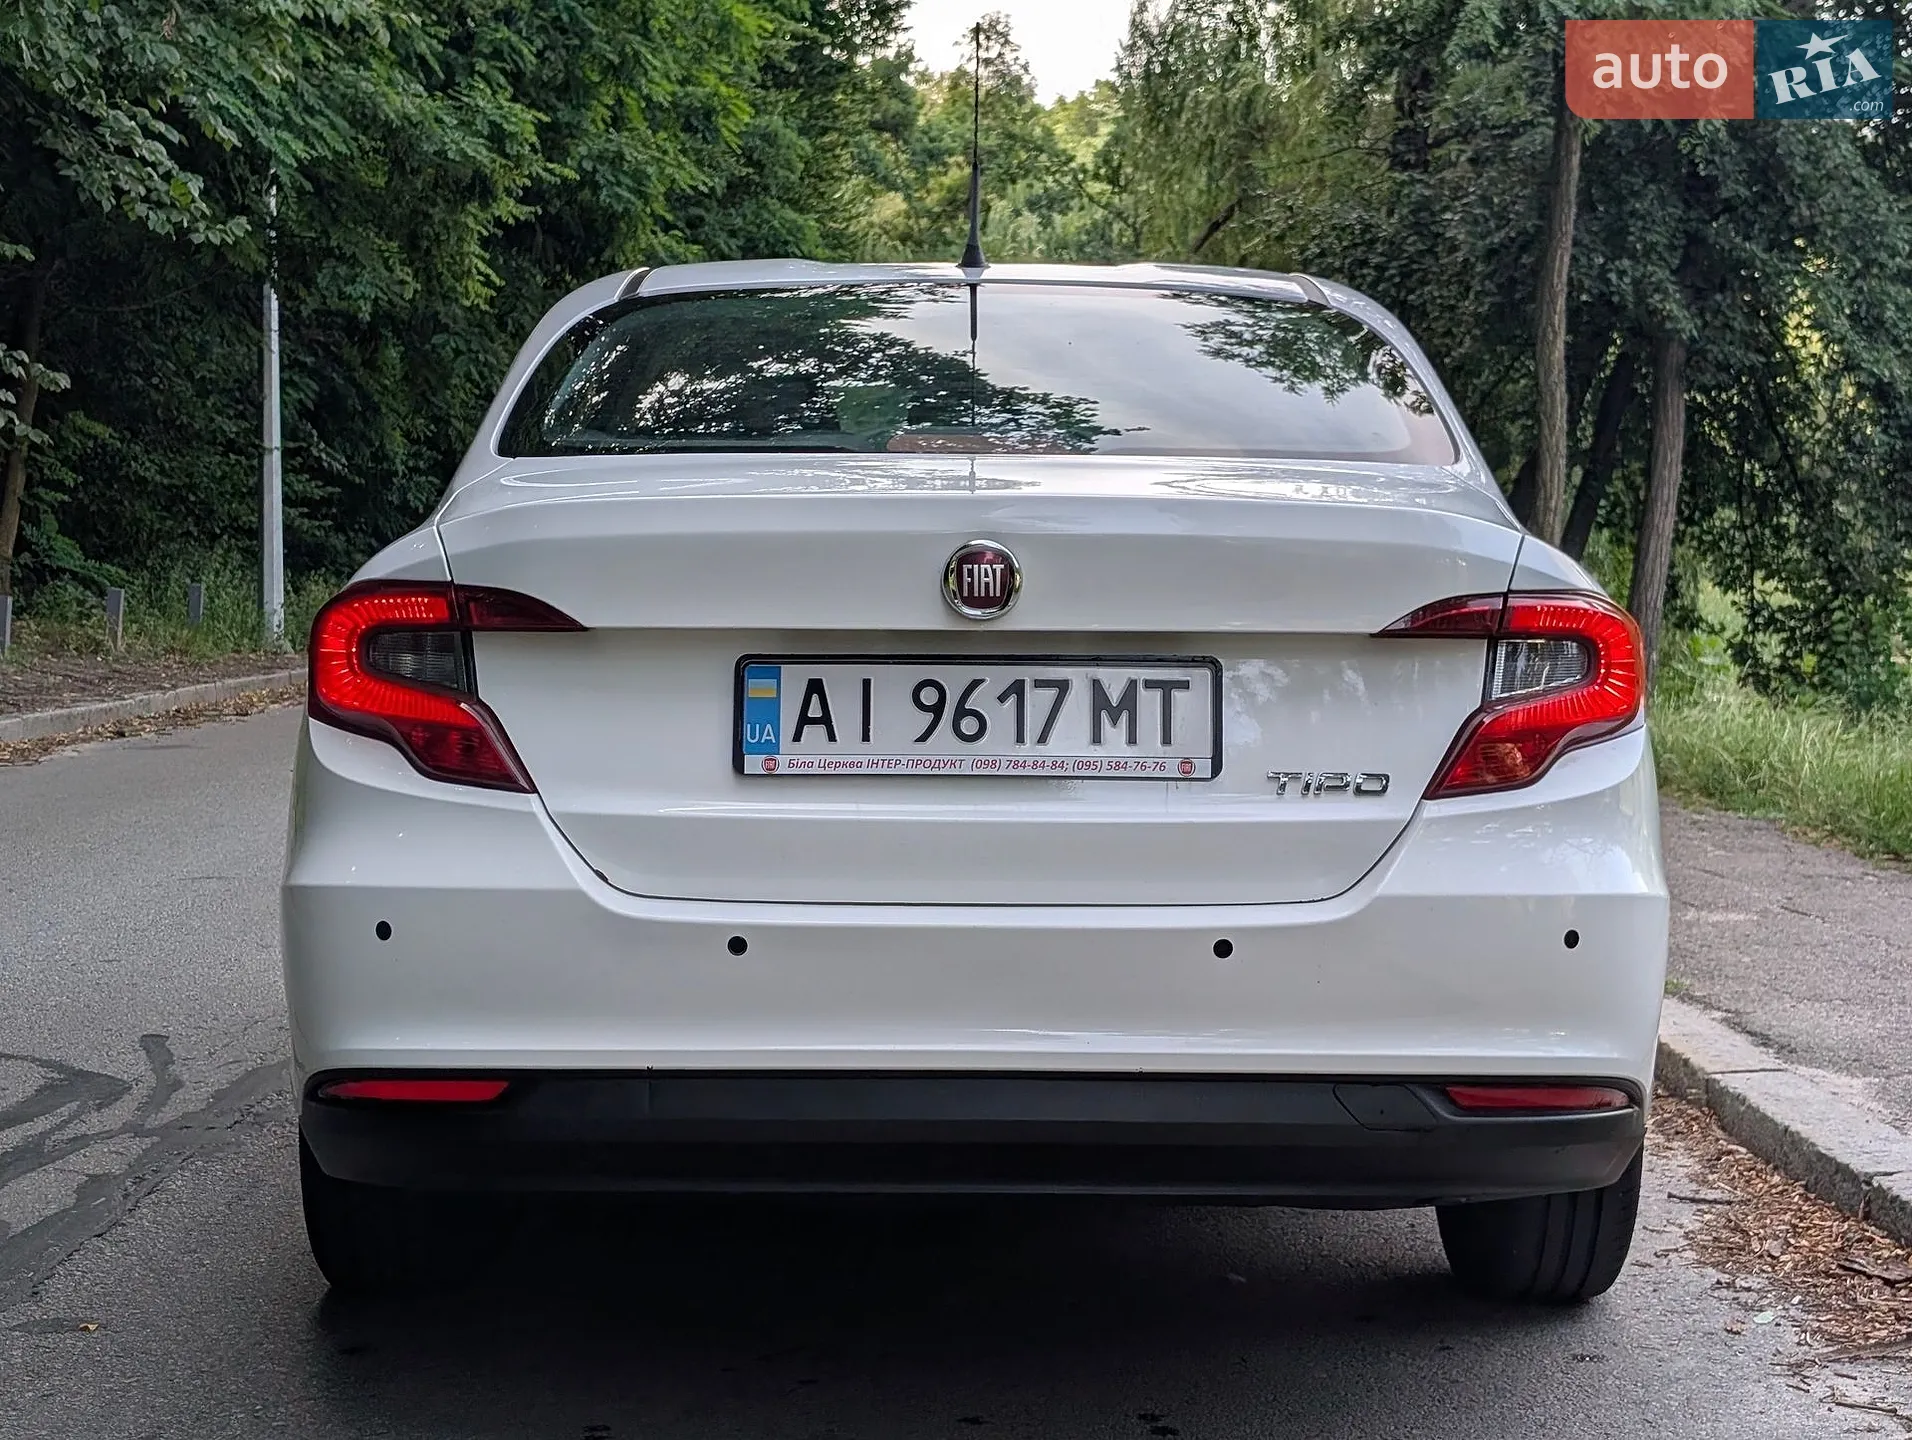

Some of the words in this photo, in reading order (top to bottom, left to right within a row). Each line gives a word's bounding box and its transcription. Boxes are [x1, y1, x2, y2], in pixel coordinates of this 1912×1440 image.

[962, 563, 1005, 597] FIAT
[791, 677, 871, 743] AI
[910, 677, 1071, 745] 9617
[1092, 678, 1190, 745] MT
[746, 723, 777, 743] UA
[787, 758, 814, 769] Біла
[817, 758, 863, 771] Церква
[866, 757, 966, 771] ІНТЕР-ПРОДУКТ
[970, 758, 1002, 772] (098)
[1005, 759, 1069, 773] 784-84-84;
[1072, 759, 1102, 773] (095)
[1105, 760, 1167, 773] 584-76-76
[1267, 771, 1391, 796] TIPO
